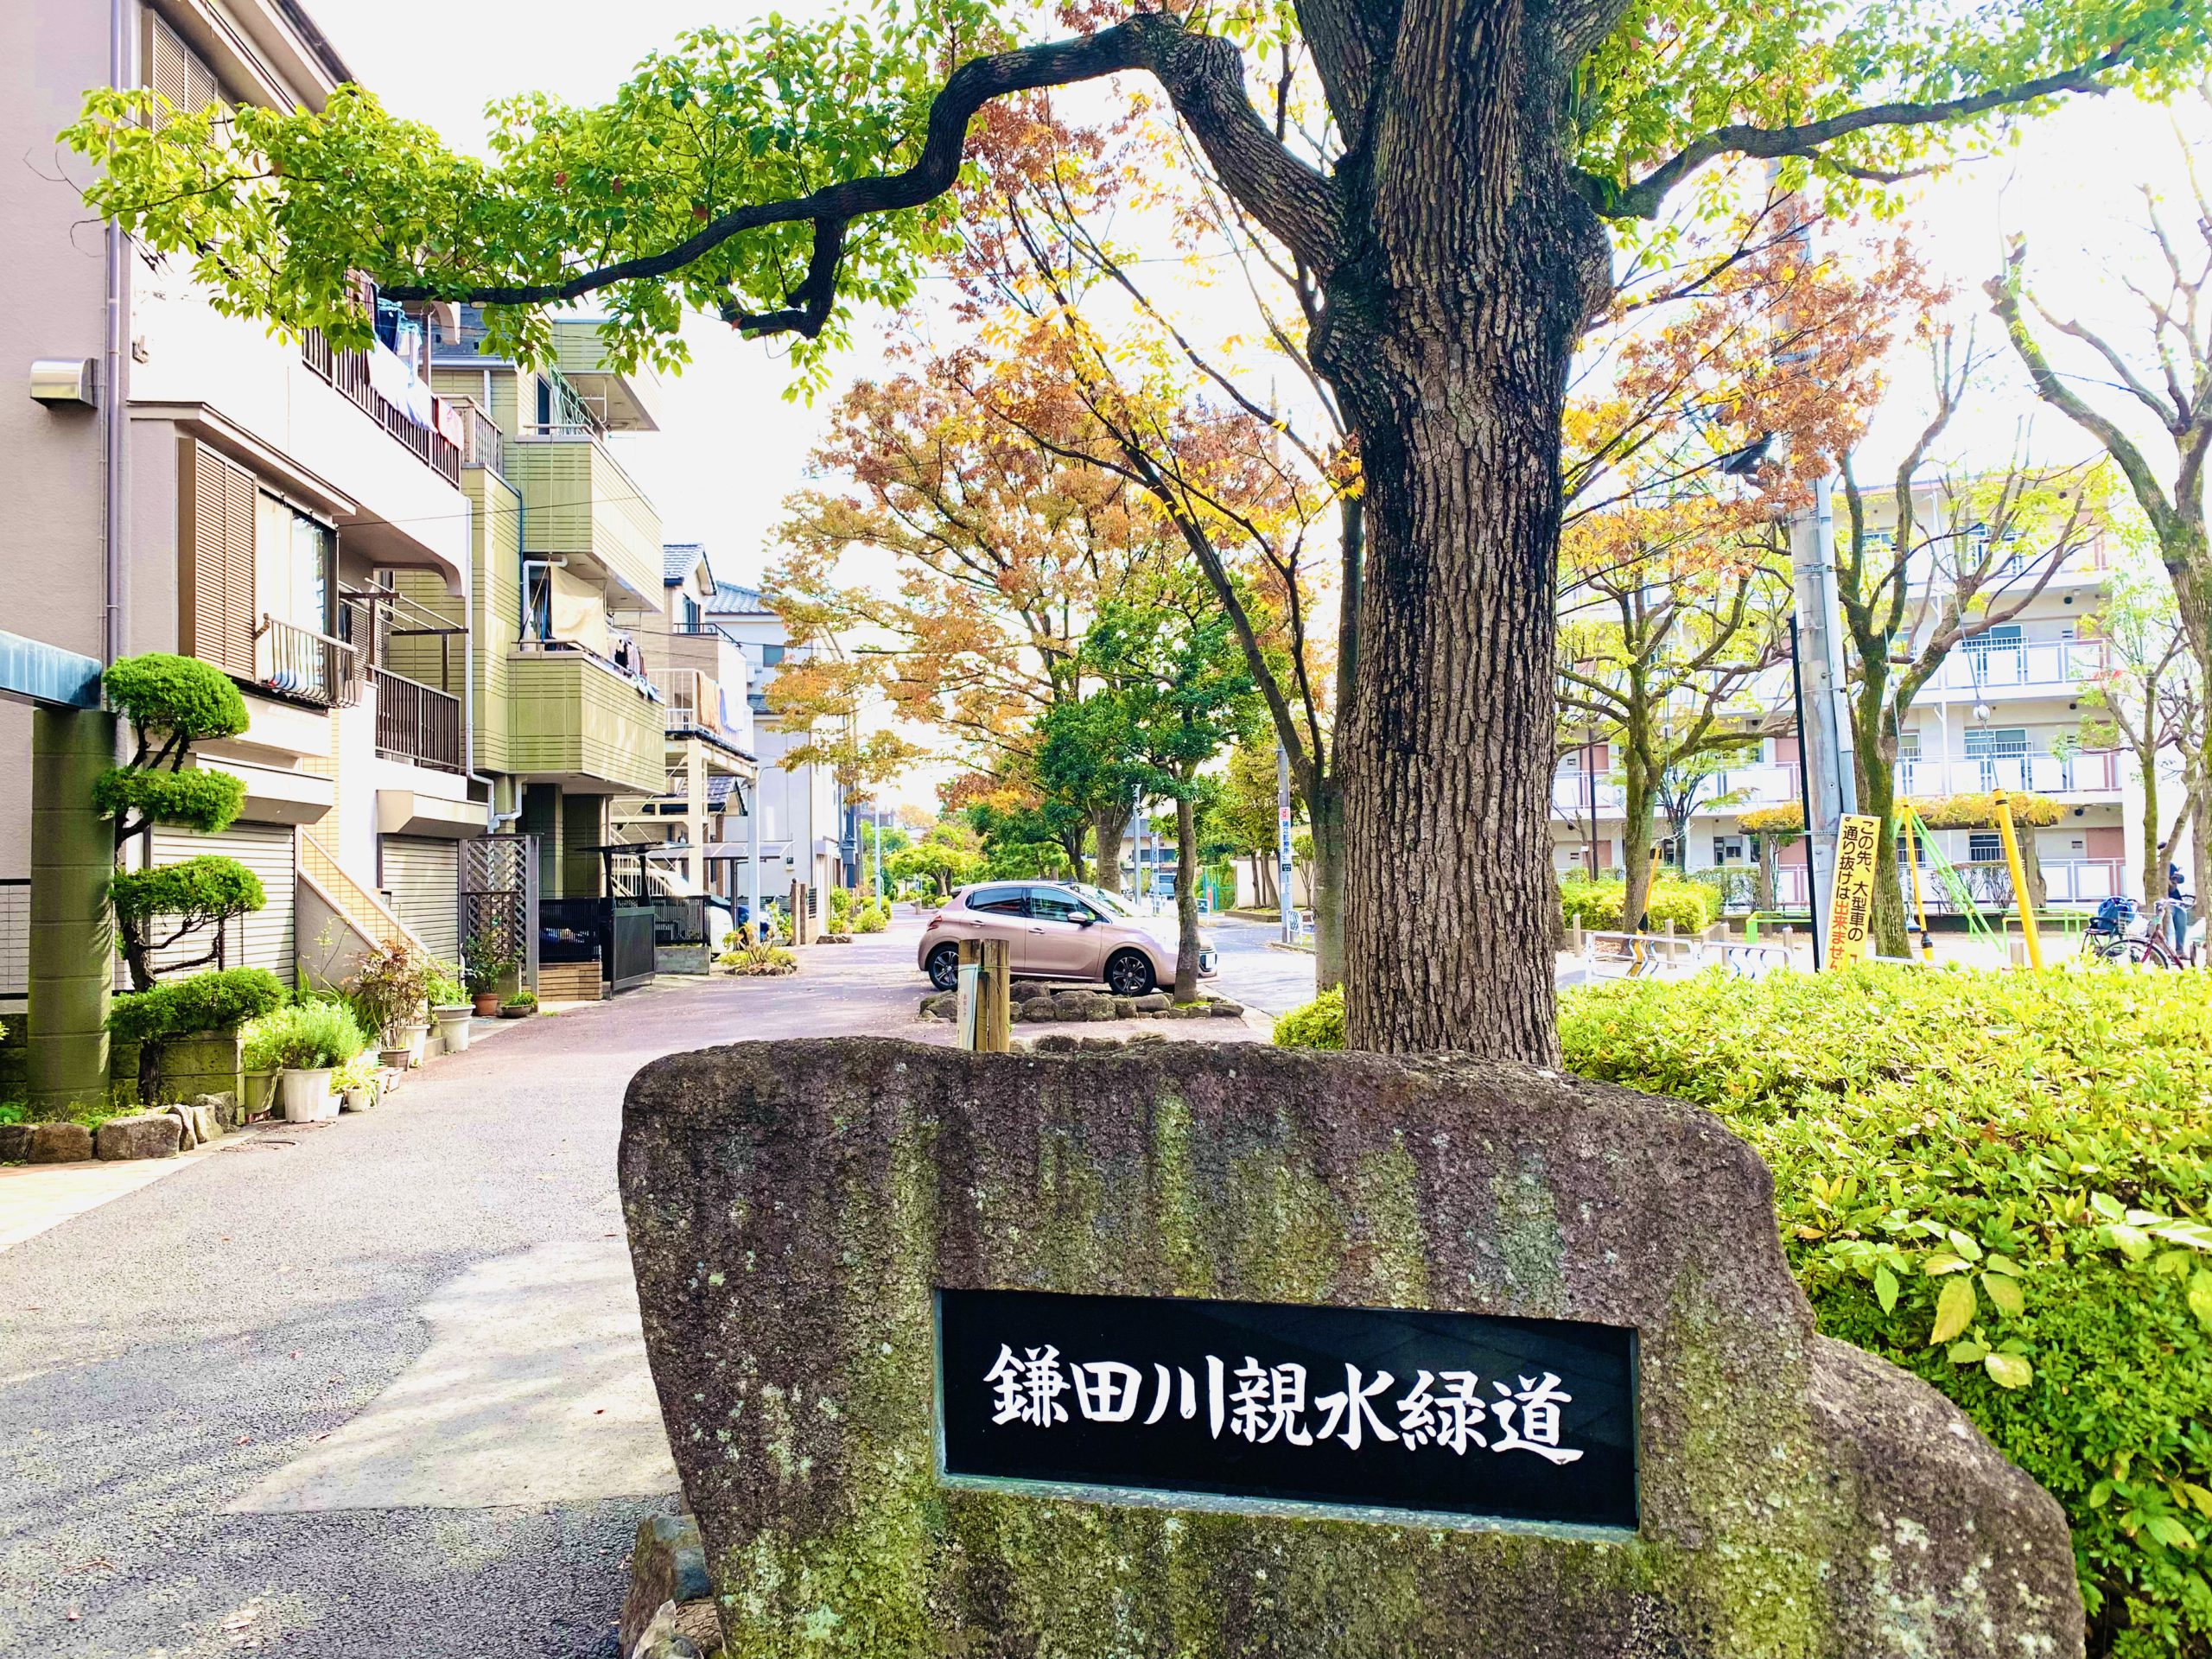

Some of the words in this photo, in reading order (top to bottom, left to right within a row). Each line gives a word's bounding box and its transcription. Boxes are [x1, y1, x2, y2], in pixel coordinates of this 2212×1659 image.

[1847, 821, 1873, 942] この先、大型車の
[983, 1344, 1584, 1465] 鎌田川親水緑道
